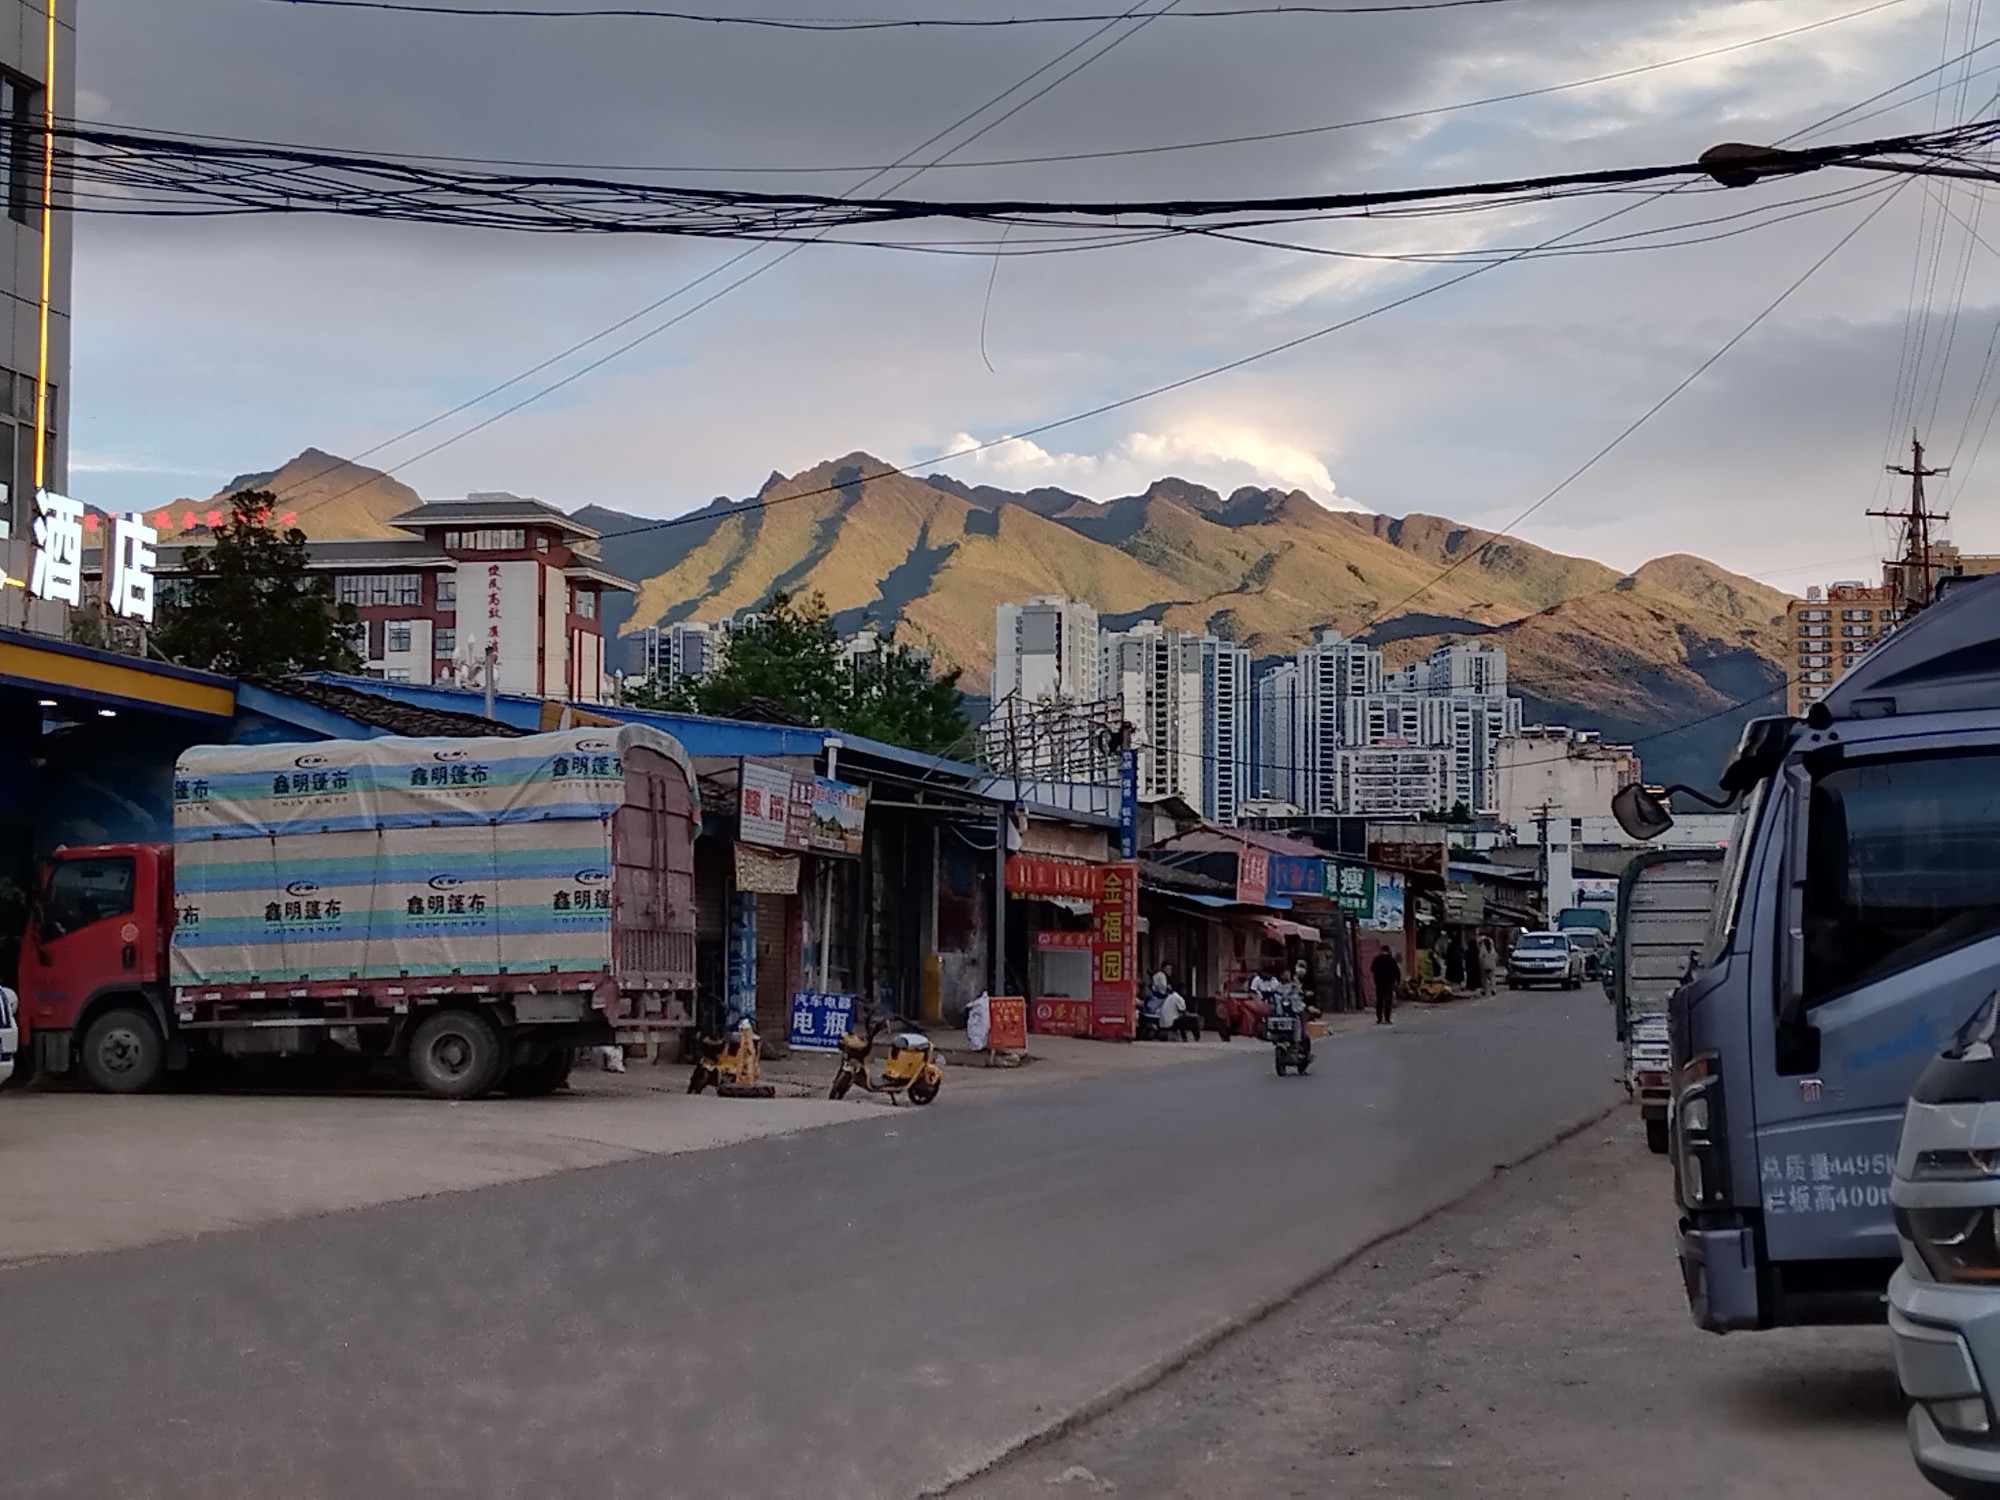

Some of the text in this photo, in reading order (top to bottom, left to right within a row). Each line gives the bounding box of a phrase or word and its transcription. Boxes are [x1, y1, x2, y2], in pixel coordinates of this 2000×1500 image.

[31, 488, 157, 623] 酒店
[273, 771, 349, 795] 鑫明篷布
[410, 765, 488, 786] 鑫明篷布
[265, 899, 341, 922] 鑫明篷布
[407, 893, 486, 915] 鑫明篷布
[793, 1008, 849, 1037] 电瓶
